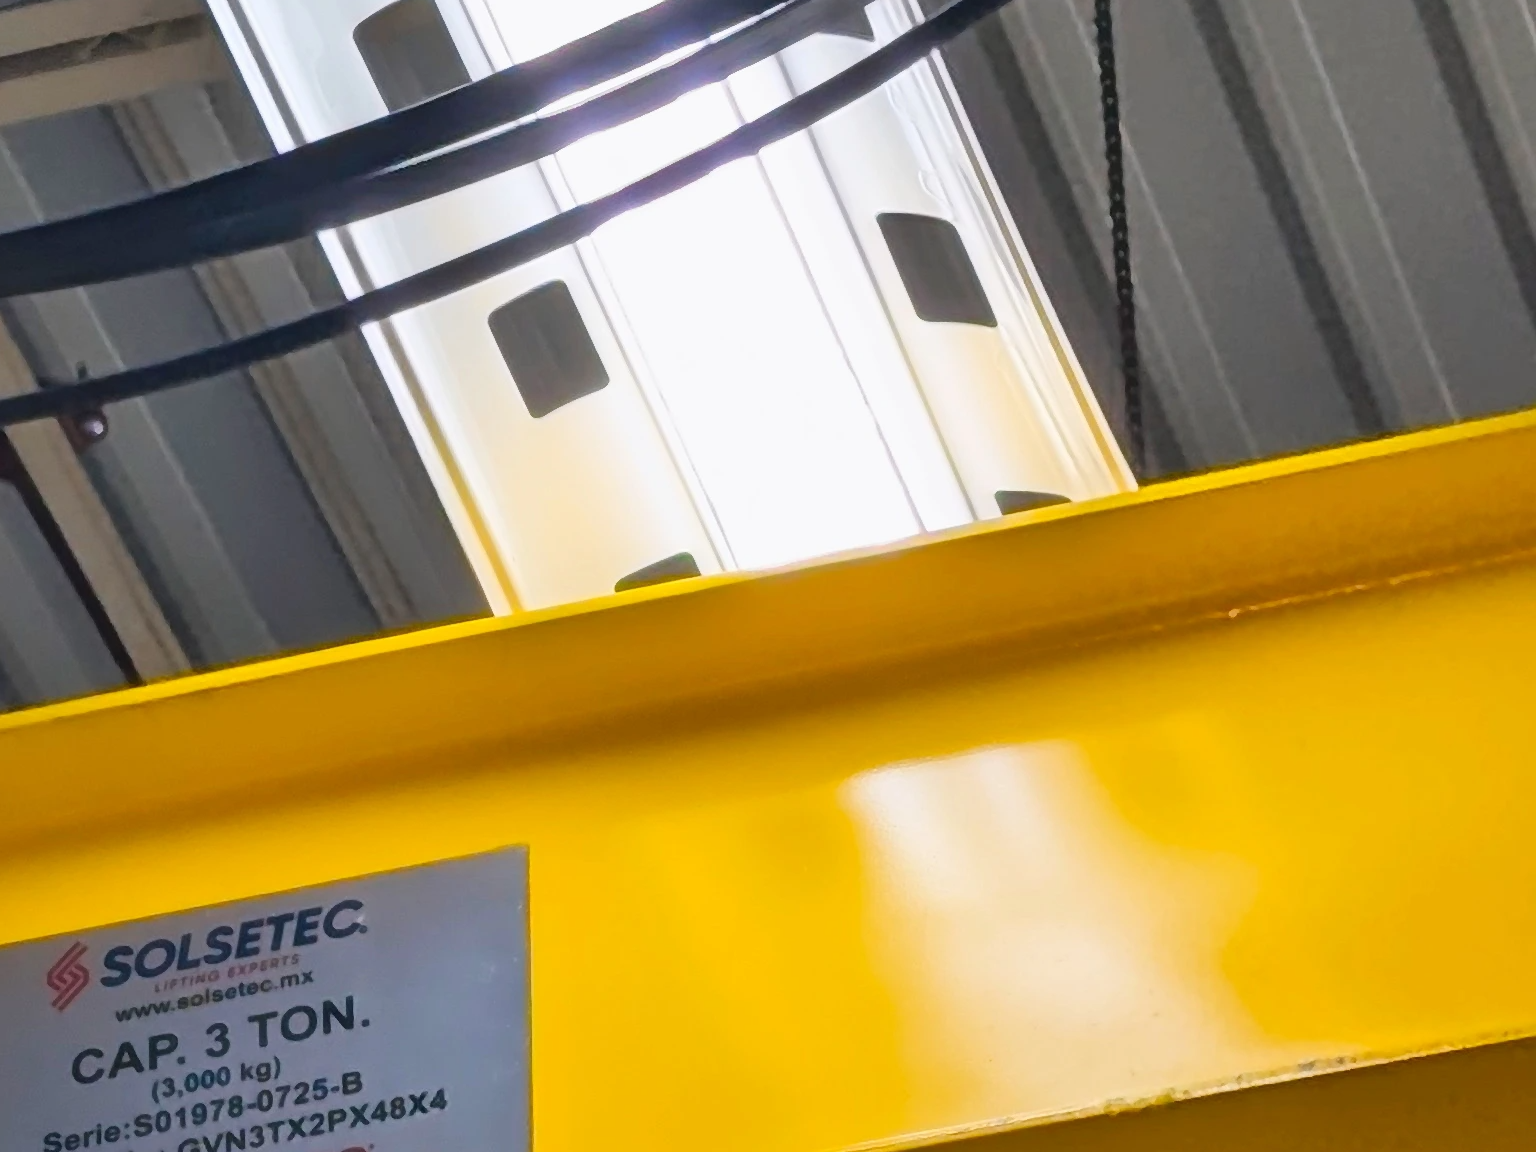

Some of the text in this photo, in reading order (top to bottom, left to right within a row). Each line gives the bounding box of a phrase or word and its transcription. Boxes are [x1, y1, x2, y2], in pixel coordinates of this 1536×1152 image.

[115, 969, 314, 1022] www.solsetec.mx
[154, 953, 300, 993] LIFTING EXPERTS
[71, 995, 370, 1084] CAP. 3 TON.
[151, 1056, 281, 1104] (3,000 kg)
